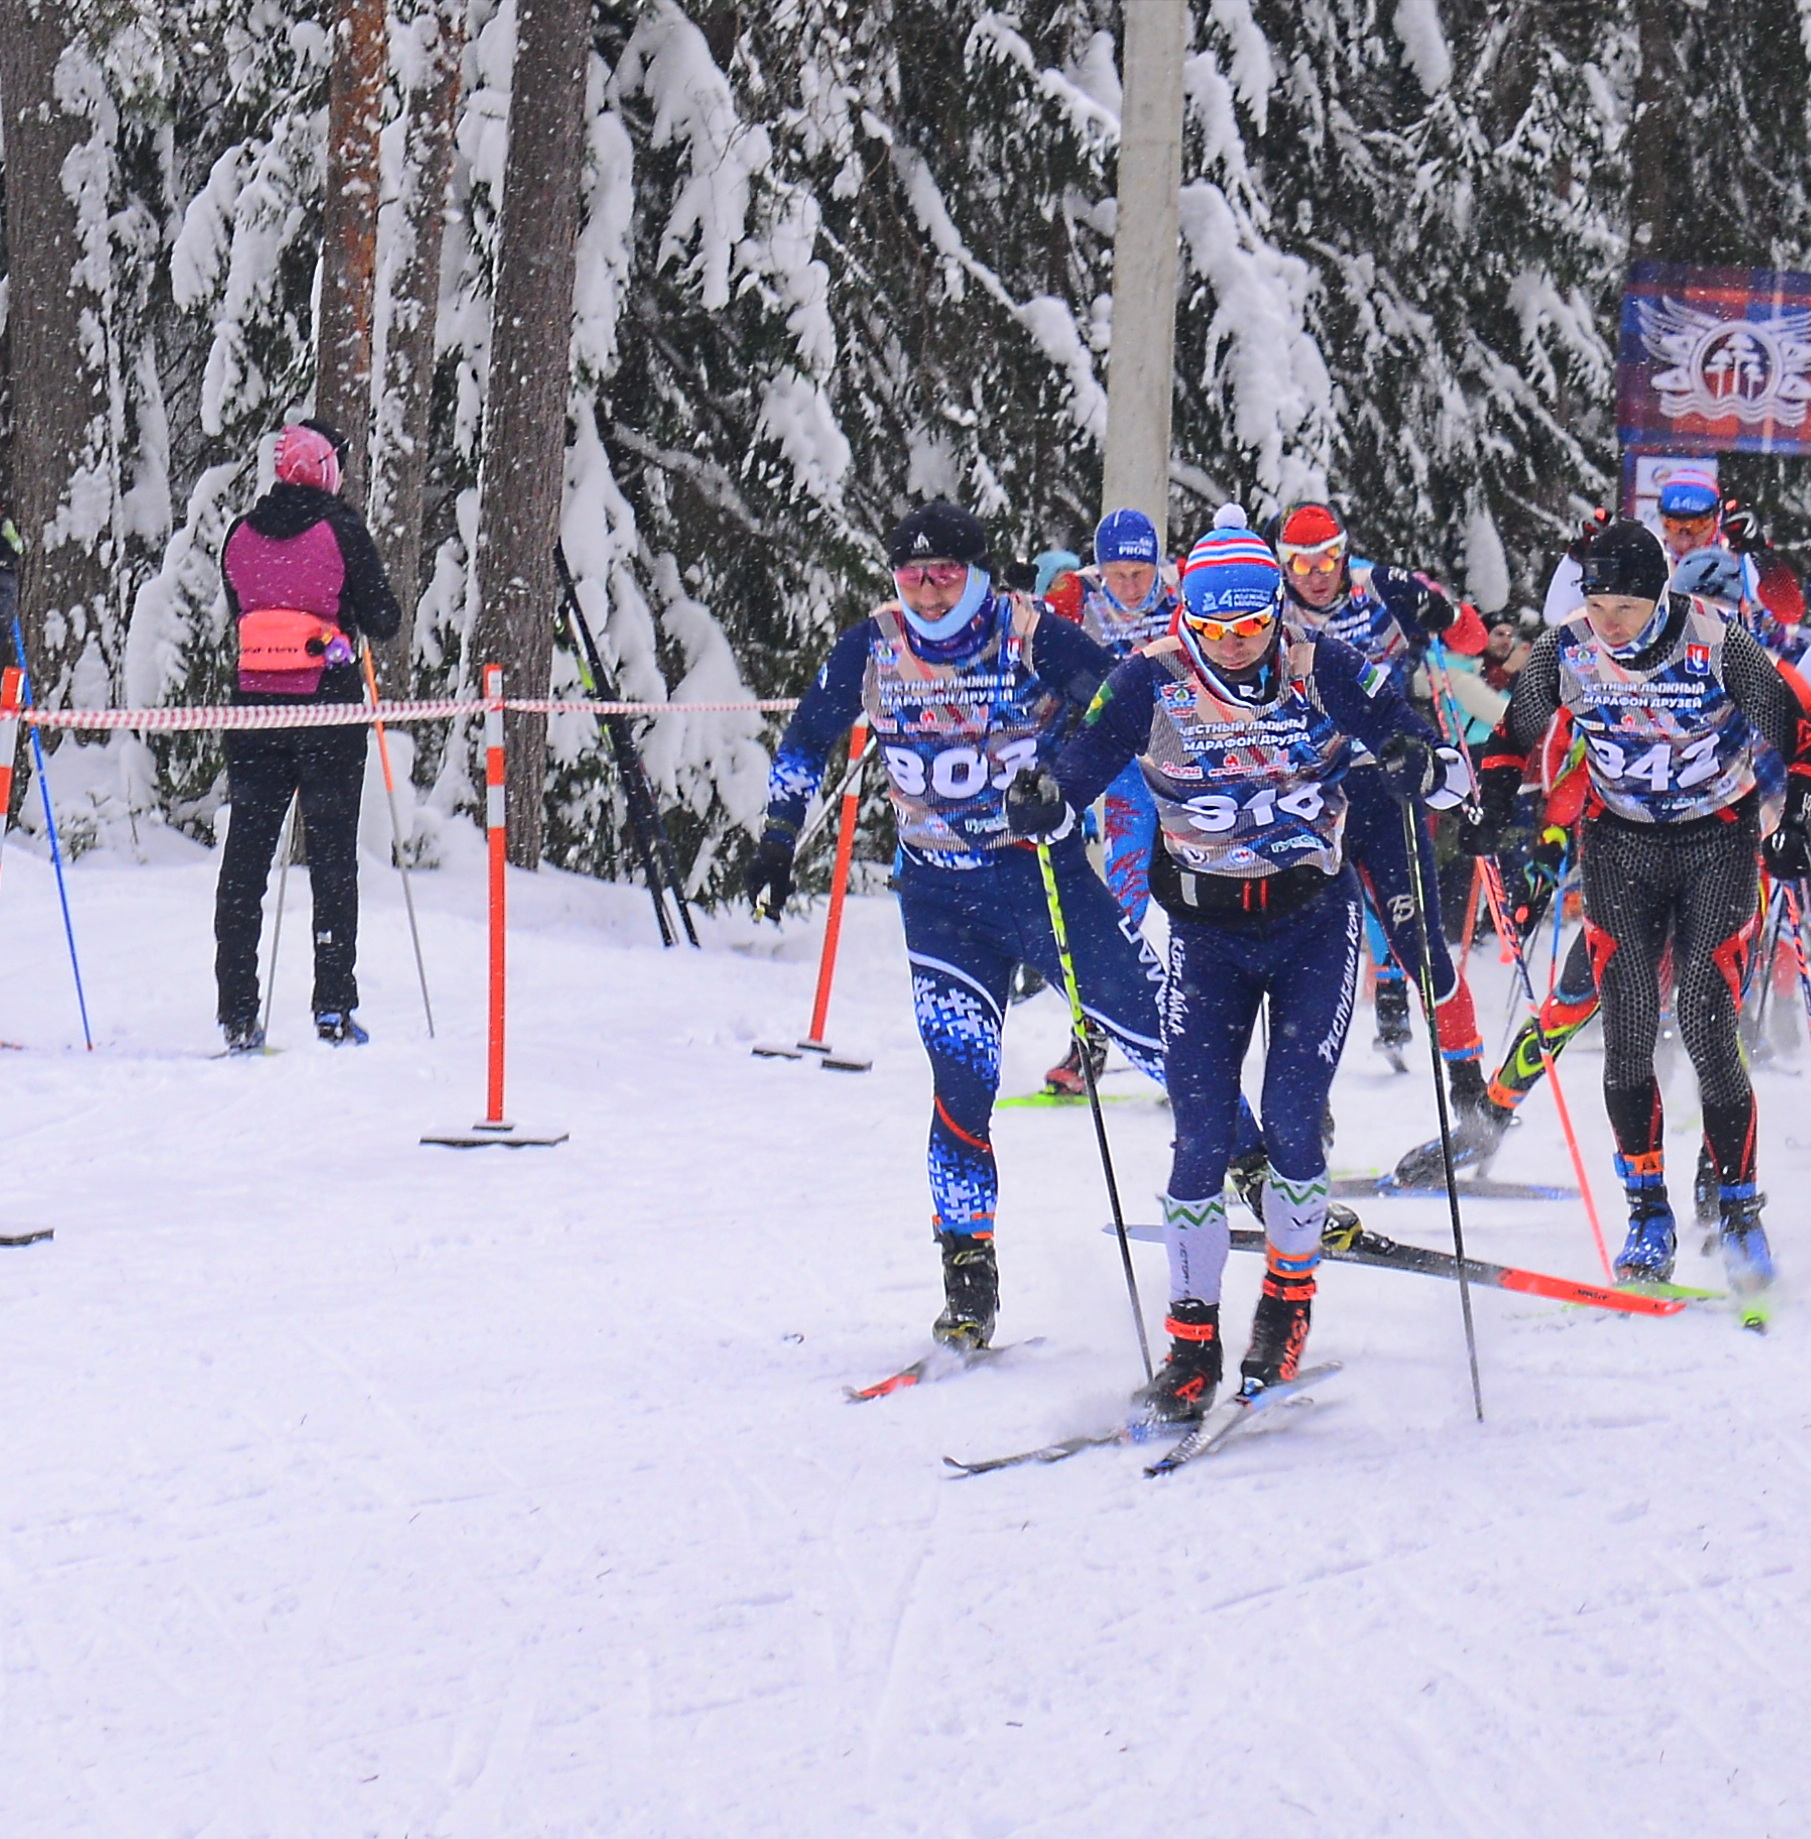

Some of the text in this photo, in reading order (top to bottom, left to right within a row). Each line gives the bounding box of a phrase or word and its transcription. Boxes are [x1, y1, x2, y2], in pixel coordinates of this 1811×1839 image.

[1640, 682, 1706, 695] ЛЫЖНЫЙ
[1583, 695, 1702, 708] МАРАФОН ДРУЗЕЙ
[1179, 719, 1245, 737] ЧЕСТНЫЙ
[1184, 735, 1257, 751] МАРАФОН
[1588, 732, 1721, 791] 342
[1181, 782, 1325, 832] 316
